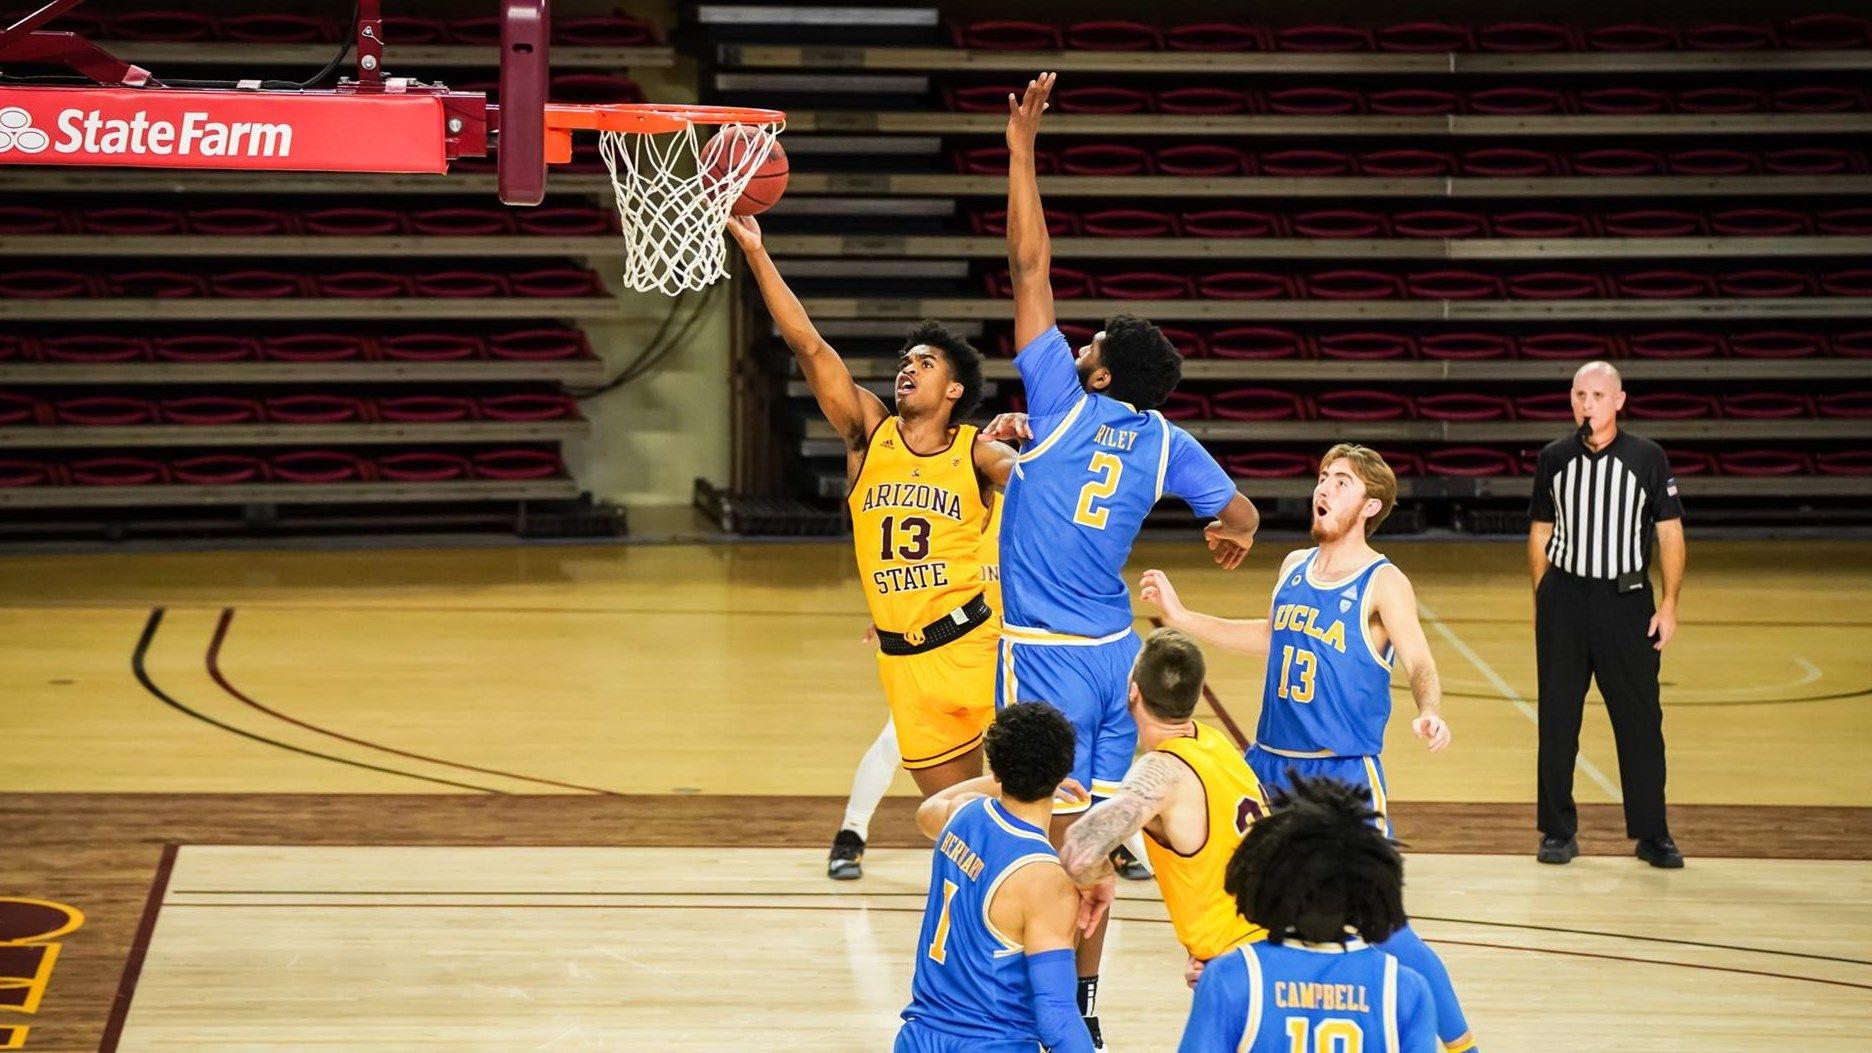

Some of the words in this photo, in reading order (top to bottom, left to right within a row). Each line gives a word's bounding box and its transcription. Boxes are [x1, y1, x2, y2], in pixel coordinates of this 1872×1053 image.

[1093, 424, 1138, 451] RILEY
[862, 483, 962, 521] ARIZONA
[1073, 450, 1123, 530] 2
[880, 515, 932, 561] 13
[873, 563, 948, 595] STATE
[1274, 604, 1347, 654] UCLA
[1278, 645, 1318, 704] 13
[928, 878, 960, 965] 1
[1275, 981, 1370, 1013] CAMPBELL
